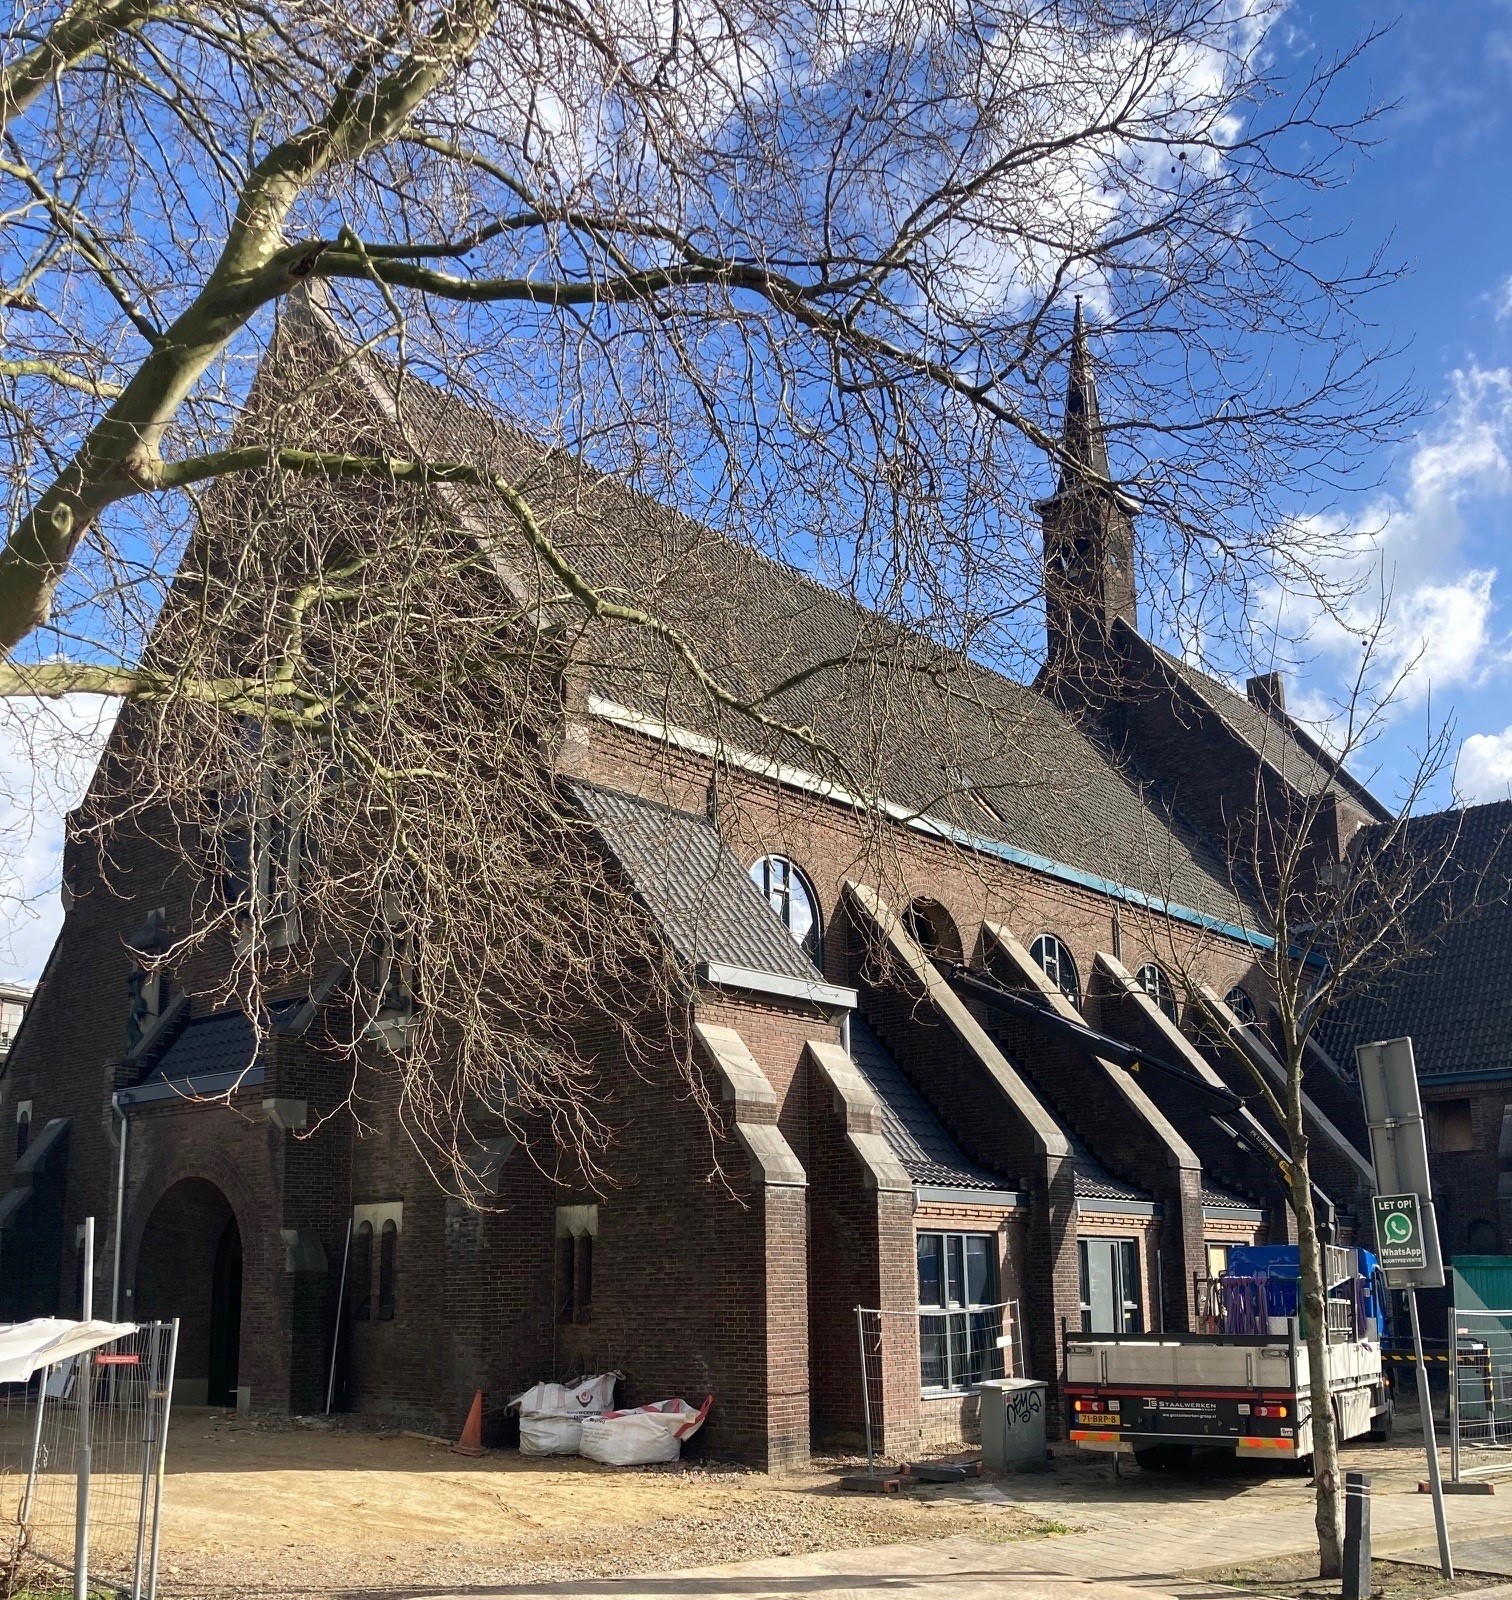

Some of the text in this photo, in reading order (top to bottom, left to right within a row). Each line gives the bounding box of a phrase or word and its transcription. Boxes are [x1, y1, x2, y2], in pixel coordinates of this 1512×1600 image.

[1378, 1200, 1412, 1211] LET OP!
[1381, 1247, 1422, 1257] WhatsApp
[1082, 1414, 1116, 1424] 71-BRP-8
